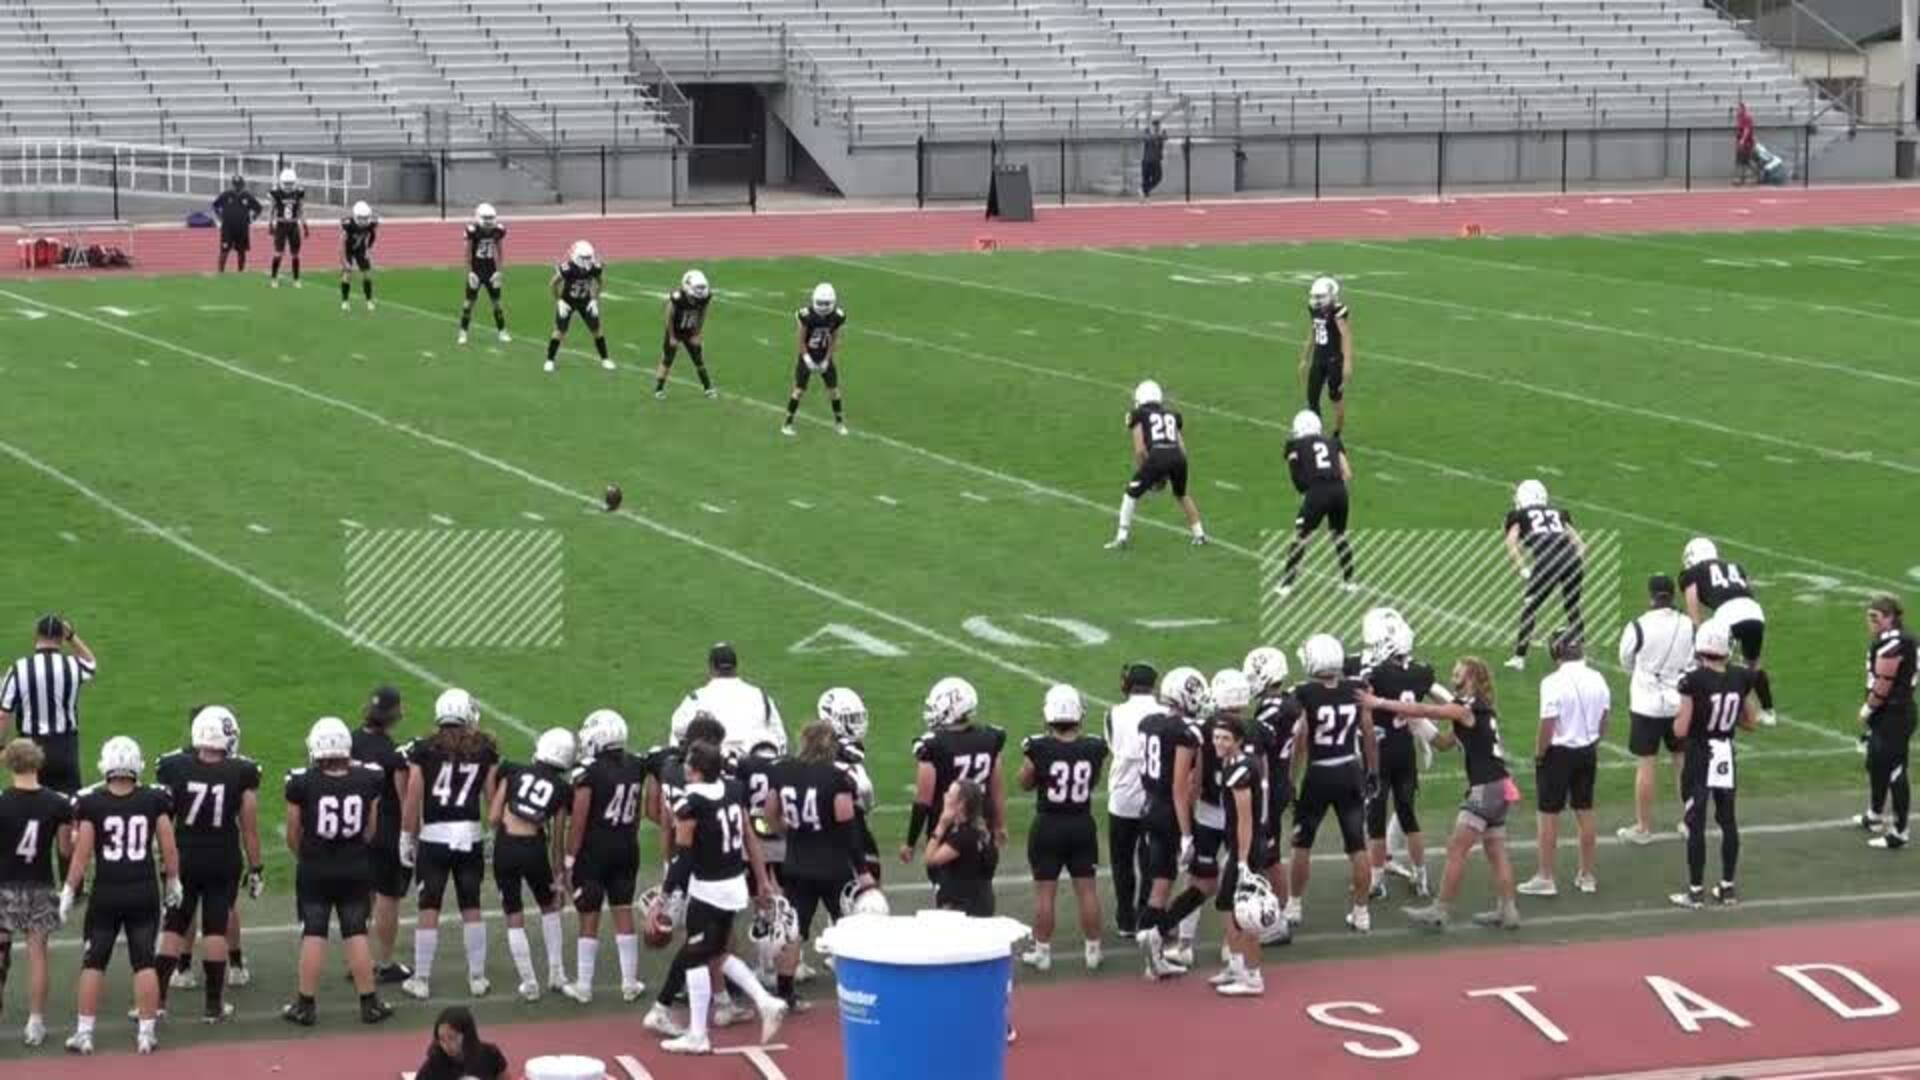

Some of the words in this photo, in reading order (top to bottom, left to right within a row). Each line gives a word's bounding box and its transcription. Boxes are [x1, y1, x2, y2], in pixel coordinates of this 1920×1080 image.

[1149, 413, 1176, 442] 28
[1313, 442, 1331, 469] 2
[1528, 509, 1564, 534] 23
[1709, 563, 1746, 588] 44
[1315, 704, 1356, 745] 27
[1708, 692, 1741, 731] 10
[432, 761, 480, 806] 47
[954, 752, 991, 794] 72
[1048, 760, 1092, 803] 38
[185, 780, 225, 828] 71
[317, 794, 363, 839] 69
[604, 783, 641, 826] 46
[780, 786, 821, 831] 64
[16, 819, 39, 862] 4
[103, 815, 148, 861] 30
[717, 803, 743, 853] 13
